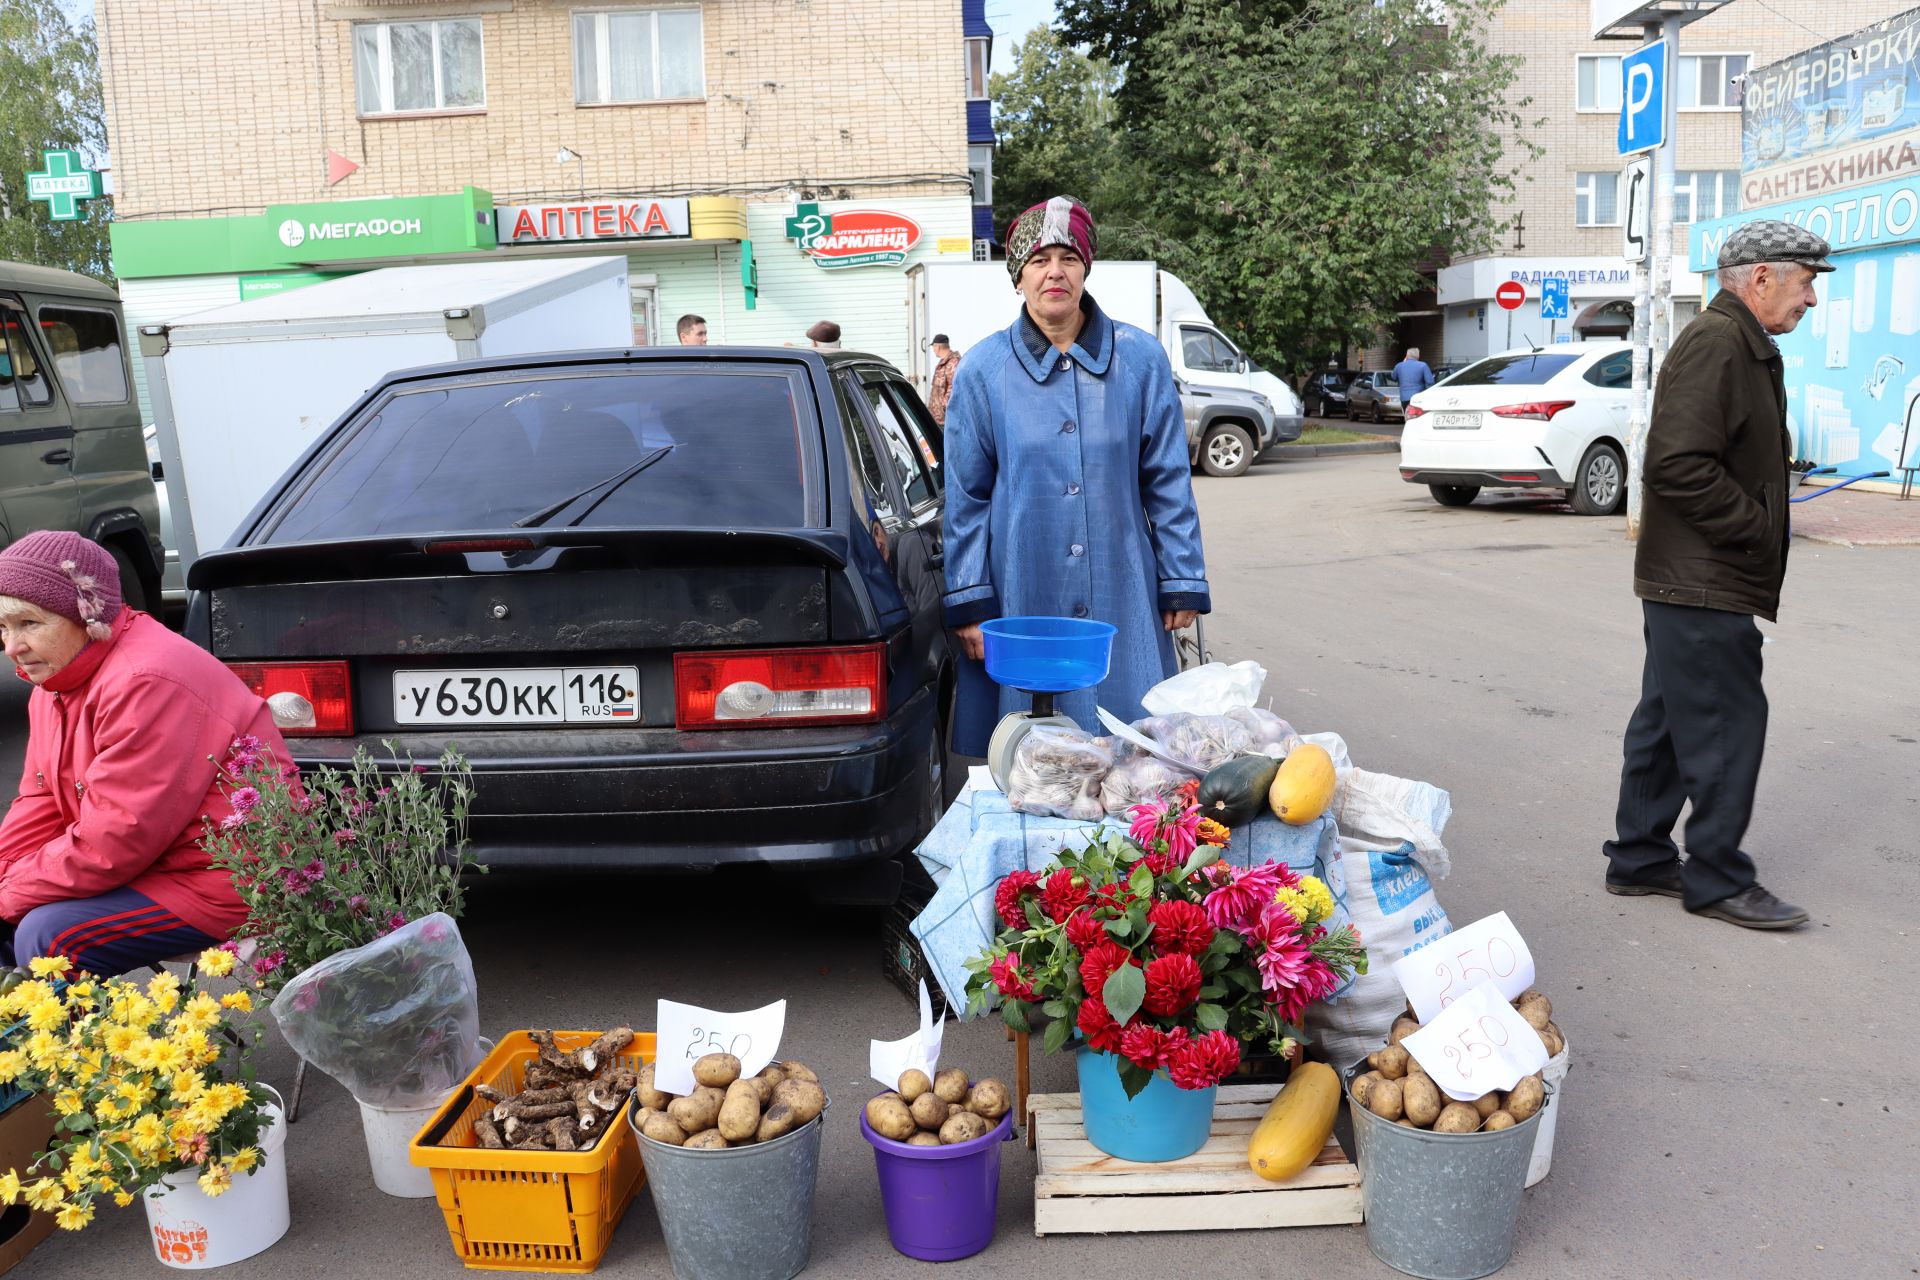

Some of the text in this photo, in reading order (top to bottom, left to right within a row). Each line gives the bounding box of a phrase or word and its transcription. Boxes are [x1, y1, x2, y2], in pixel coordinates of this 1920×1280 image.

[1627, 63, 1653, 140] P
[35, 179, 85, 189] АПТЕКА
[1745, 140, 1917, 204] САНТЕХНИКА
[512, 203, 671, 239] АПТЕКА
[812, 233, 908, 250] ФАРМЛЕНД
[1511, 270, 1629, 283] РАДИОДЕТАЛИ
[569, 673, 626, 704] 116
[582, 705, 611, 716] RUS
[1436, 937, 1516, 1008] 250
[686, 1027, 752, 1060] 250
[1444, 1016, 1508, 1079] 250
